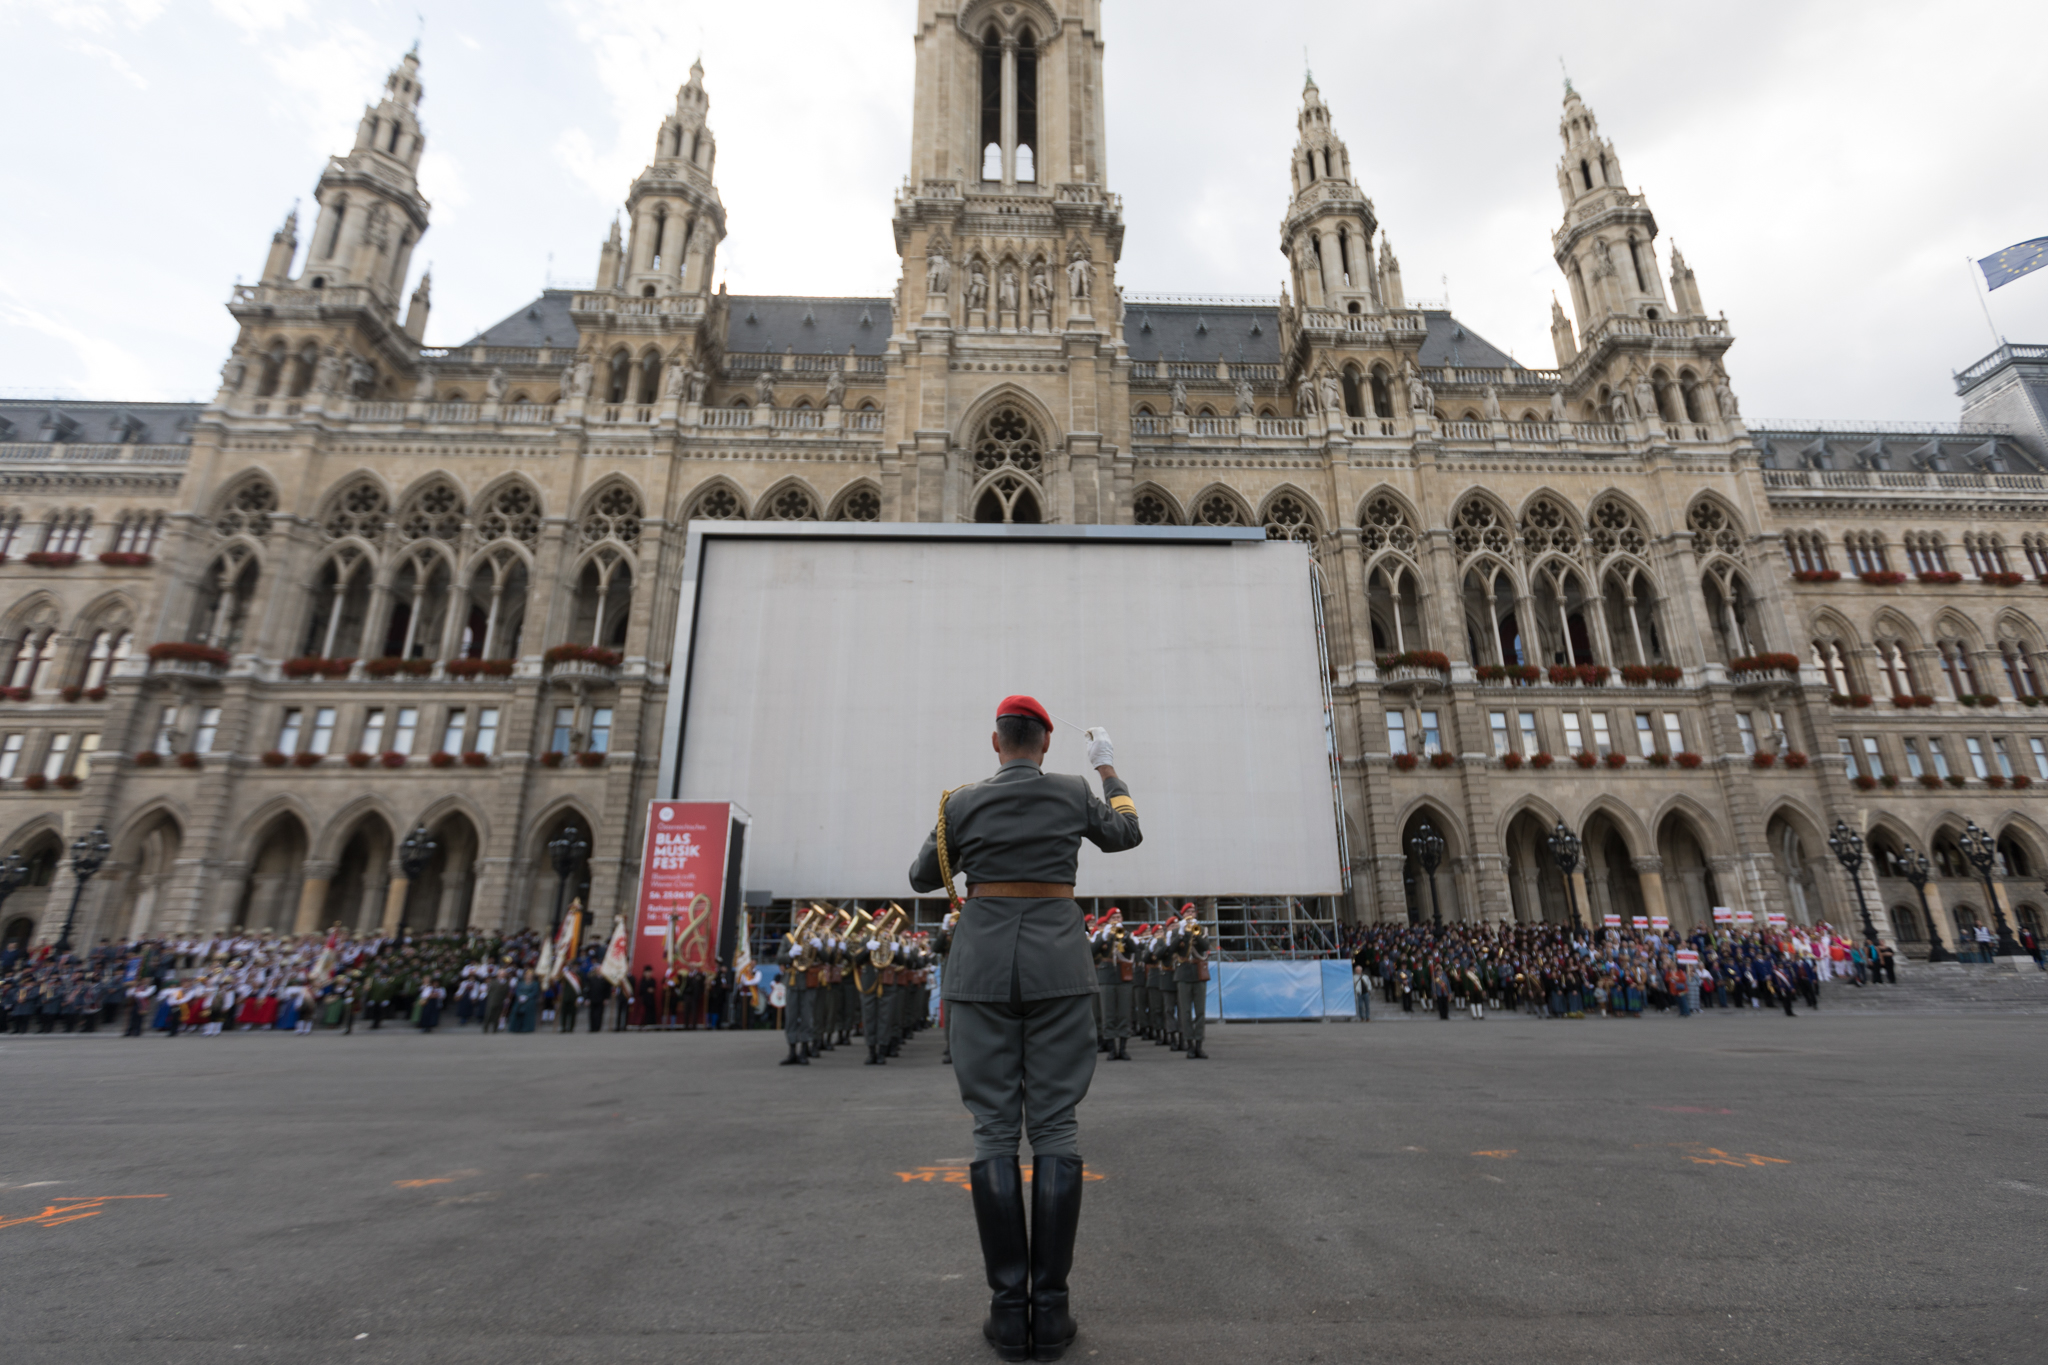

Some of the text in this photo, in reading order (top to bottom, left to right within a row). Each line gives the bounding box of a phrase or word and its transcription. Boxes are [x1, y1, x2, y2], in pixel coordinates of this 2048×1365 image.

[656, 833, 691, 844] BLAS
[654, 845, 700, 857] MUSIK
[652, 857, 687, 869] FEST
